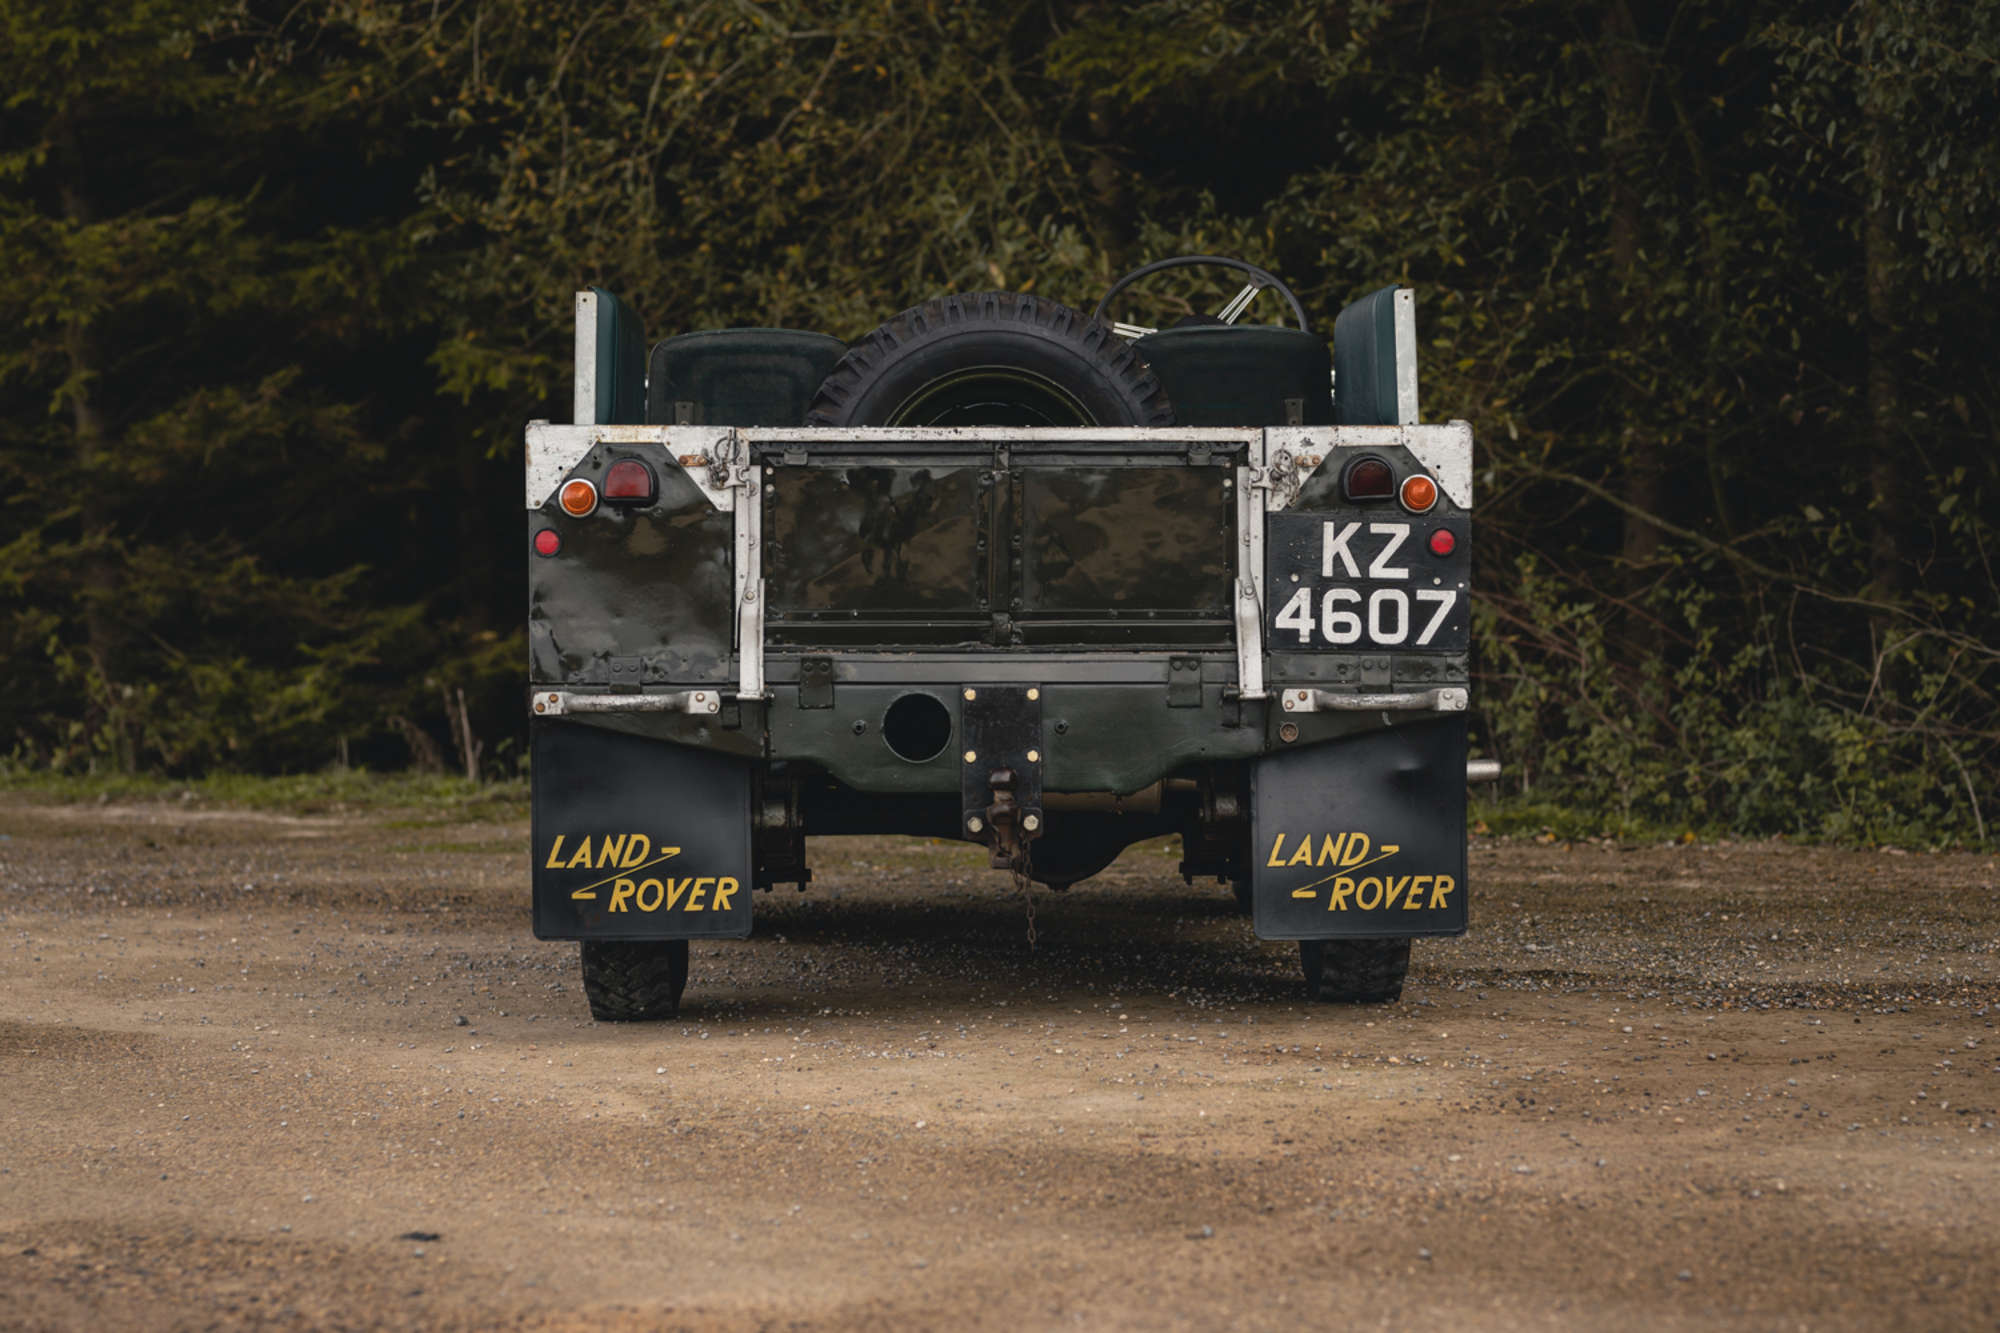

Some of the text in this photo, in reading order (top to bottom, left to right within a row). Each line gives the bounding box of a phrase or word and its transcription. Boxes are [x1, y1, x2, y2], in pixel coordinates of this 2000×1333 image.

[1321, 521, 1411, 580] KZ
[1275, 586, 1457, 646] 4607
[545, 833, 651, 869] LAND
[1266, 831, 1371, 868] LAND
[608, 876, 740, 913] ROVER
[1327, 874, 1456, 911] ROVER
